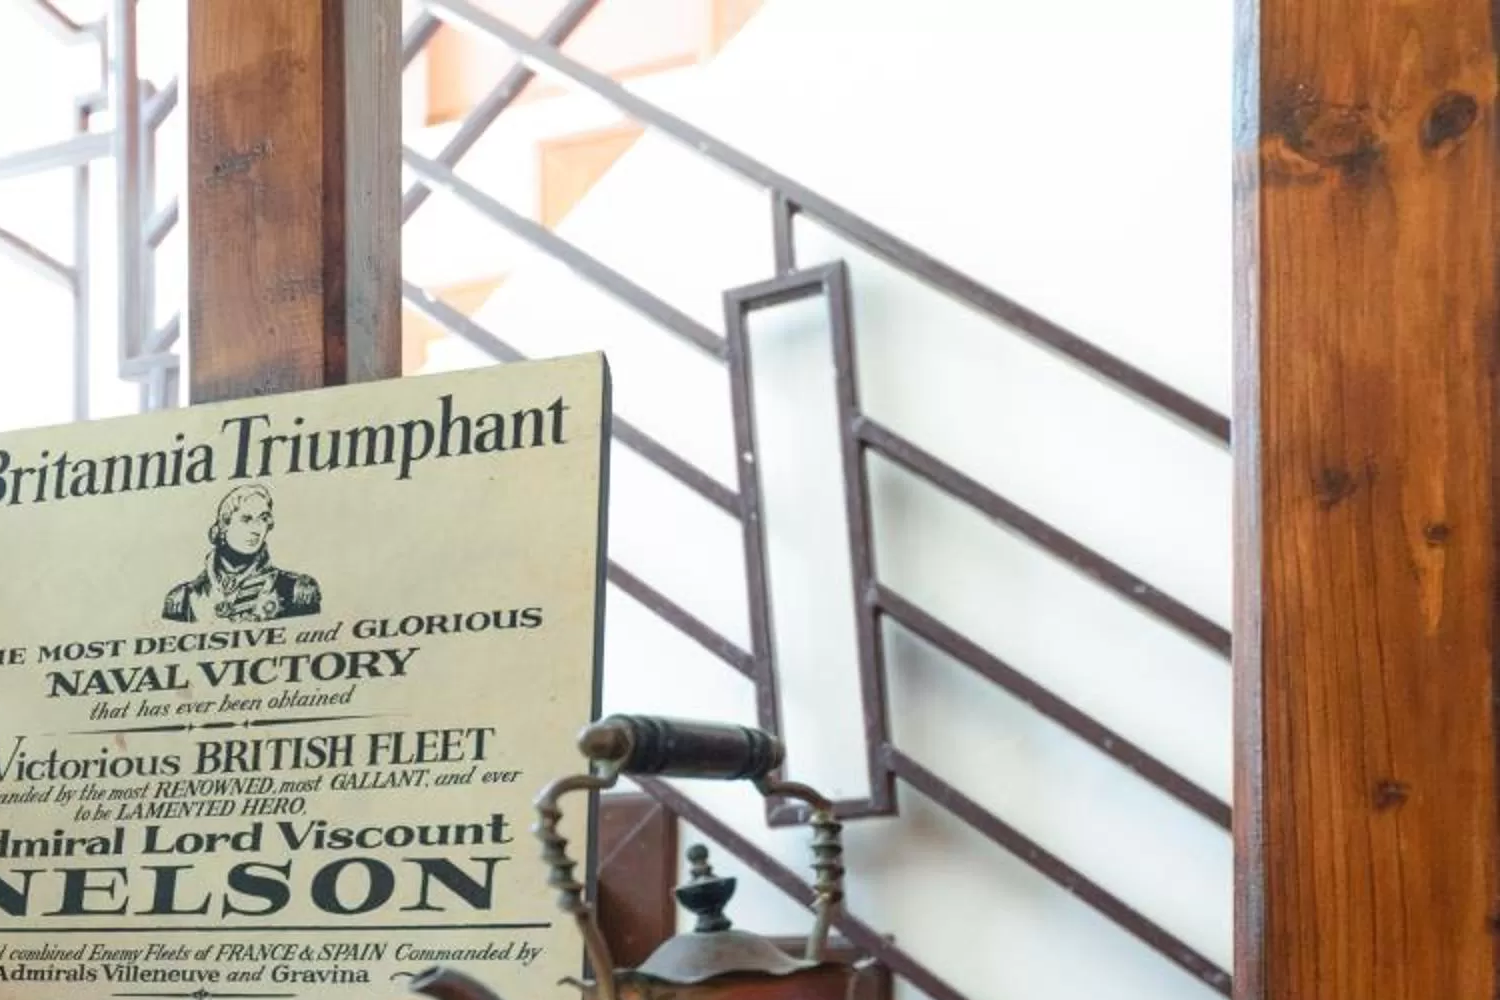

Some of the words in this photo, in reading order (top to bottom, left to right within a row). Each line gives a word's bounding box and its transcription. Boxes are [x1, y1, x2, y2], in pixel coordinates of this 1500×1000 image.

[221, 393, 571, 482] Triumphant
[40, 640, 126, 664] MOST
[133, 627, 286, 656] DECISIVE
[296, 621, 343, 643] and
[352, 606, 544, 640] GLORIOUS
[45, 663, 190, 699] NAVAL
[198, 647, 421, 689] VICTORY
[89, 701, 129, 721] that
[138, 699, 169, 718] has
[175, 700, 217, 716] ever
[218, 693, 260, 713] been
[267, 684, 357, 709] obtained
[192, 733, 357, 776] BRITISH
[366, 726, 497, 768] FLEET
[58, 785, 80, 806] by
[79, 783, 110, 801] the
[108, 782, 150, 801] most
[279, 775, 323, 793] most
[435, 765, 476, 786] and
[482, 769, 523, 784] ever
[74, 804, 91, 822] to
[92, 806, 112, 821] be
[115, 798, 237, 820] LAMENTED
[141, 820, 263, 856] Lord
[276, 812, 516, 851] Viscount
[9, 943, 89, 961] combined
[88, 943, 140, 965] Enemy
[144, 943, 191, 962] Fleets
[193, 942, 216, 964] of
[216, 943, 298, 962] FRANCE
[297, 944, 314, 961] &
[316, 941, 389, 962] SPAIN
[394, 941, 512, 962] Commanded
[516, 941, 543, 967] by
[100, 964, 221, 984] Villeneuve
[225, 966, 265, 983] and
[270, 963, 372, 983] Gravina
